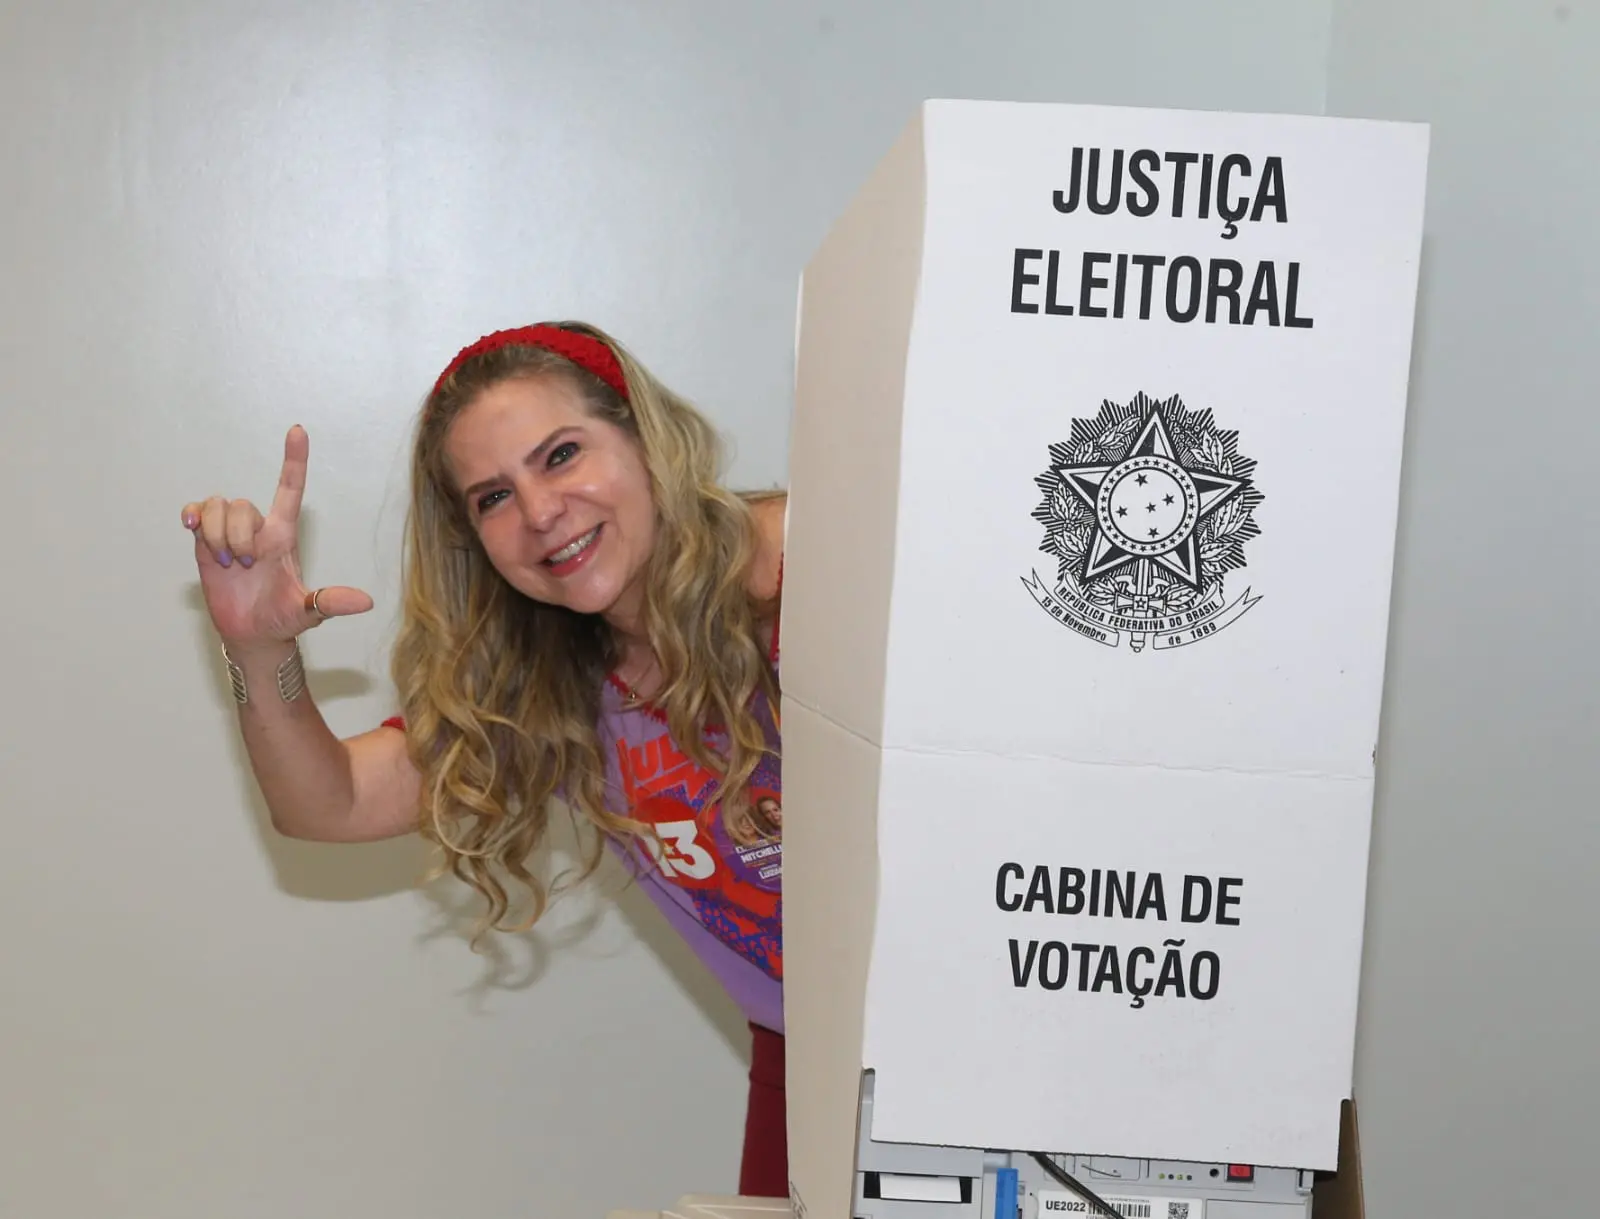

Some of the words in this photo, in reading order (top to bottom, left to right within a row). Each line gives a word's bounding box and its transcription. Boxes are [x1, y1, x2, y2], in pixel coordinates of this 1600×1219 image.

[1053, 147, 1288, 240] JUSTIÇA
[1010, 248, 1314, 329] ELEITORAL
[1041, 596, 1053, 608] 15
[1051, 605, 1063, 618] de
[1062, 613, 1107, 641] Novembro
[1108, 615, 1165, 630] FEDERATIVA
[1169, 616, 1182, 628] DO
[1186, 600, 1219, 622] BRASIL
[1168, 635, 1181, 645] de
[1190, 622, 1217, 639] 1889
[995, 862, 1168, 922] CABINA
[1180, 874, 1244, 926] DE
[1008, 938, 1220, 1009] VOTAÇÃO
[1045, 1200, 1086, 1212] UE2022
